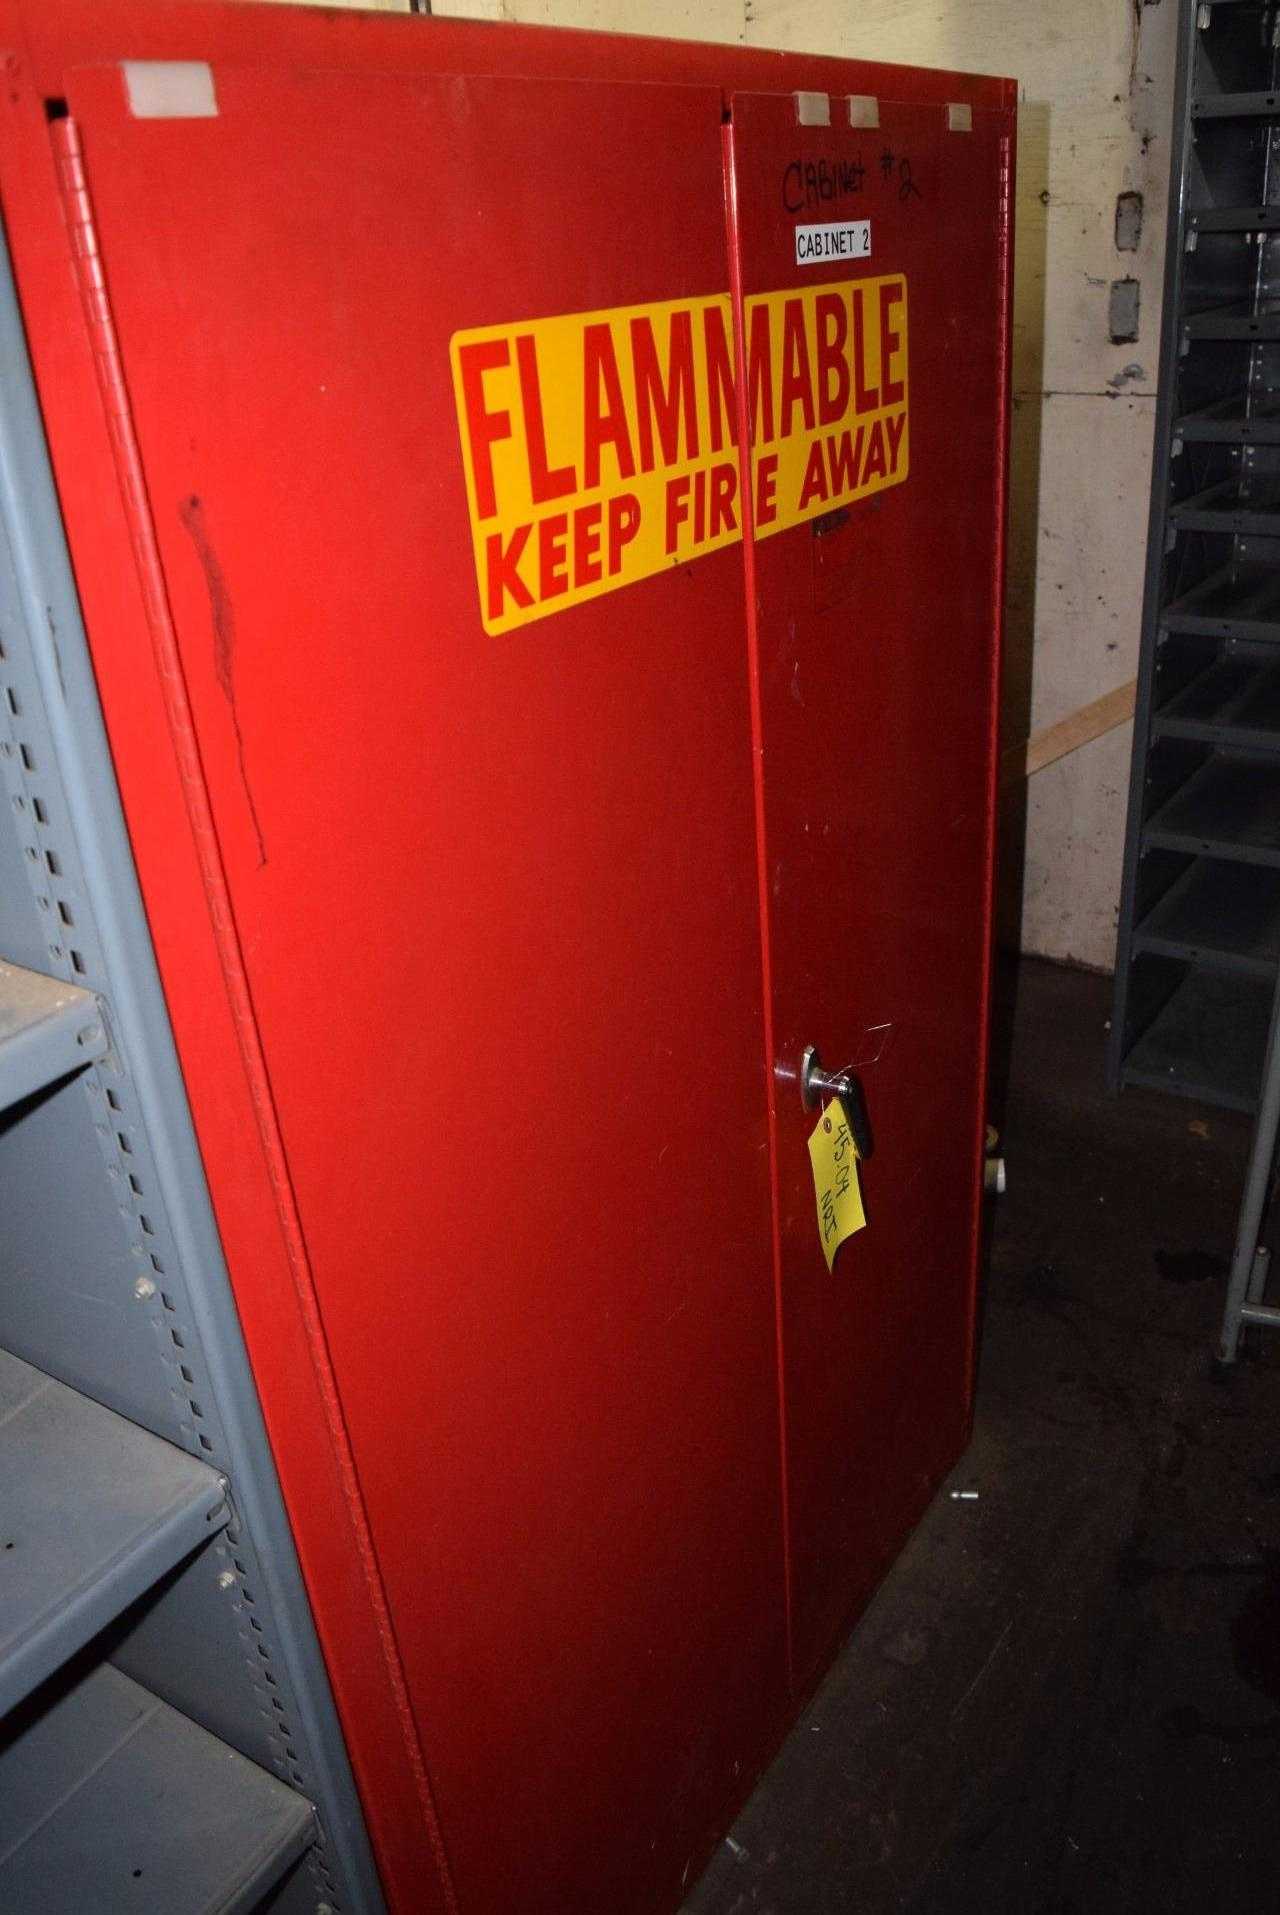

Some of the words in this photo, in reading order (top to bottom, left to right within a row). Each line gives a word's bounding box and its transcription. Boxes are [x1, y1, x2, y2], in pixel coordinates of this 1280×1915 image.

[797, 230, 855, 259] CABINET
[862, 228, 870, 251] 2
[459, 281, 904, 522] FLAMMABLE
[485, 493, 641, 622] KEEP
[665, 454, 778, 555] FIRE
[798, 412, 907, 510] AWAY
